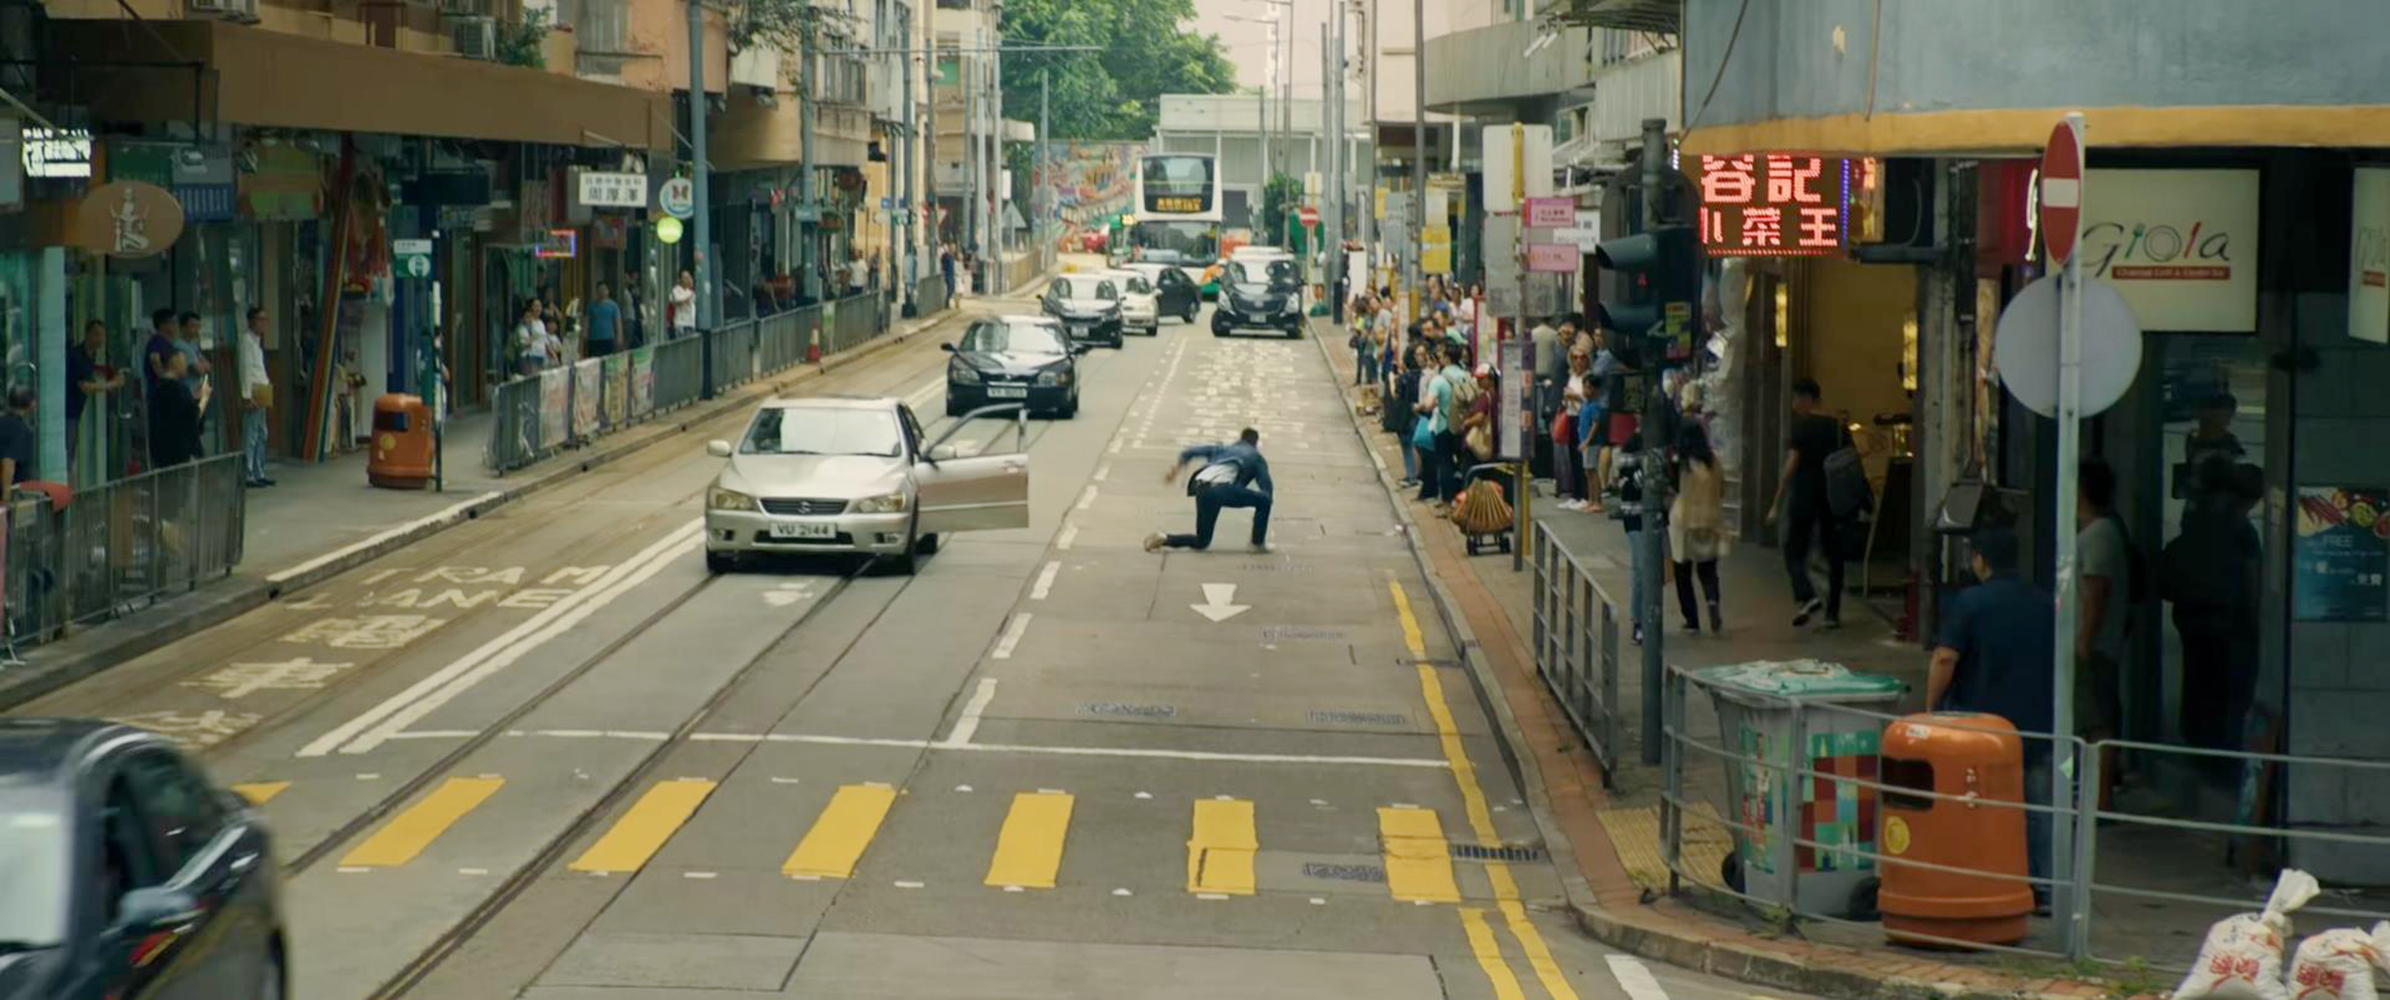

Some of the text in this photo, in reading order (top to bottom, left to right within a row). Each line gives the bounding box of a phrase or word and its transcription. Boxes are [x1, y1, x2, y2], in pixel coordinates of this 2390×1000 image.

[800, 525, 829, 536] 2144
[360, 565, 611, 586] TRAM
[286, 588, 575, 609] LANE
